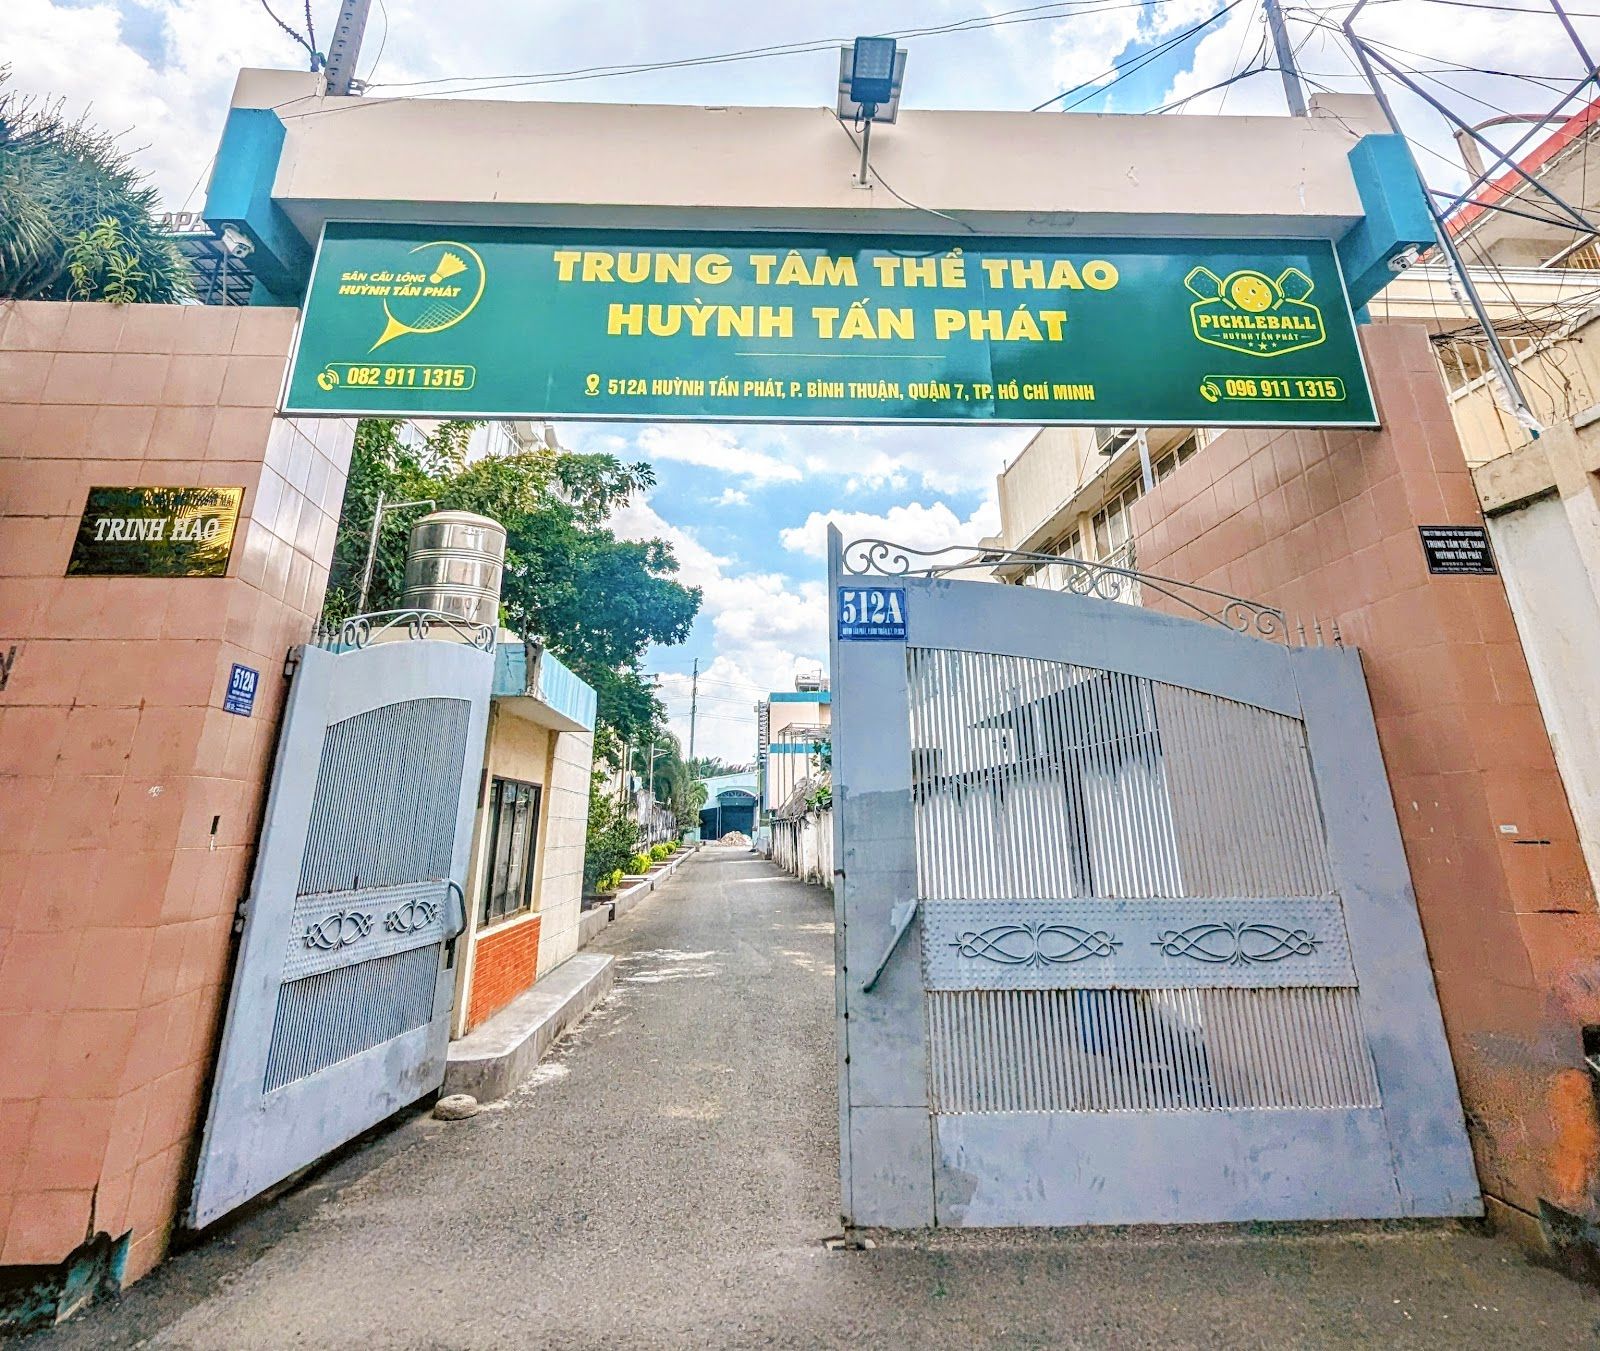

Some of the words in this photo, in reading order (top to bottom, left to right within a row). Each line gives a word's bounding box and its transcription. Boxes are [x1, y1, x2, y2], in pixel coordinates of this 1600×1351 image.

[341, 270, 368, 281] SÂN
[553, 250, 733, 284] TRUNG
[750, 249, 859, 287] TÂM
[873, 247, 967, 288] THỂ
[982, 258, 1119, 291] THAO
[338, 283, 392, 296] HUỲNH
[392, 282, 421, 296] TẤN
[422, 285, 462, 297] PHÁT
[607, 297, 794, 338] HUỲNH
[812, 297, 915, 340] TẤN
[934, 303, 1068, 341] PHÁT
[1199, 314, 1317, 330] PICKLEBALL
[347, 367, 381, 385] 082
[384, 368, 416, 386] 911
[423, 368, 465, 387] 1315
[608, 379, 648, 395] 512A
[652, 376, 705, 397] HUỲNH
[709, 375, 740, 397] TẤN
[744, 378, 786, 399] PHÁT,
[790, 382, 802, 398] P.
[807, 379, 845, 398] BÌNH
[848, 380, 904, 402] THUẬN,
[908, 380, 951, 402] QUẬN
[954, 383, 970, 401] 7,
[973, 383, 995, 400] TP.
[998, 379, 1018, 400] HỒ
[1023, 382, 1050, 400] CHÍ
[1053, 384, 1096, 400] MINH
[1225, 379, 1258, 397] 096
[1260, 380, 1291, 397] 911
[1295, 380, 1337, 398] 1315
[93, 518, 168, 542] TRINH
[842, 590, 904, 624] 512A
[232, 668, 256, 693] 512A
